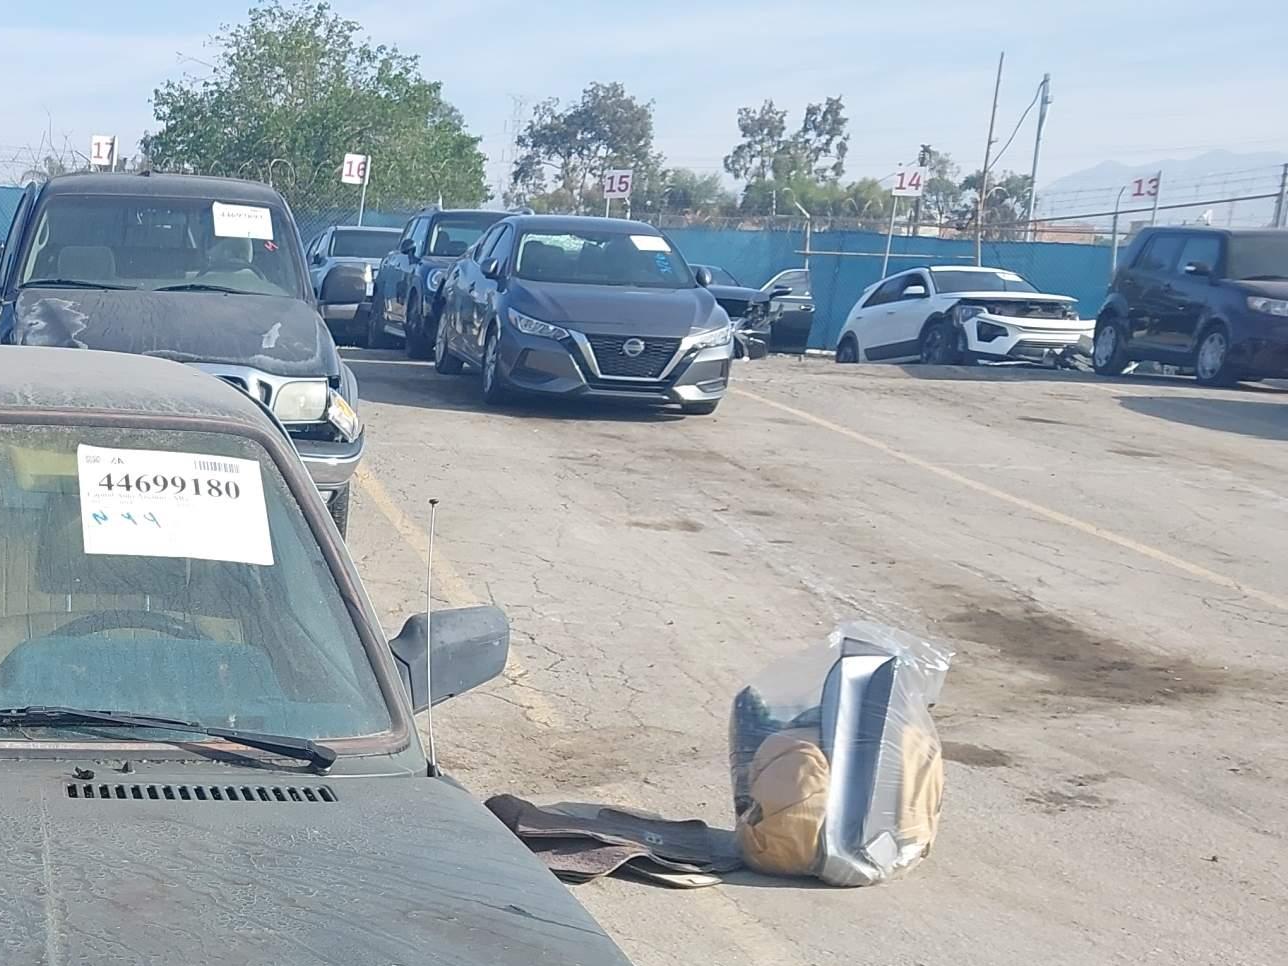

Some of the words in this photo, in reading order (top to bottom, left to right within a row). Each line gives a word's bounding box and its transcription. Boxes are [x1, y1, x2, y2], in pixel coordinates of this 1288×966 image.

[93, 141, 115, 159] 17
[344, 160, 366, 178] 16
[605, 174, 629, 193] 15
[894, 171, 922, 191] 14
[1132, 177, 1159, 196] 13
[98, 472, 240, 499] 44699180
